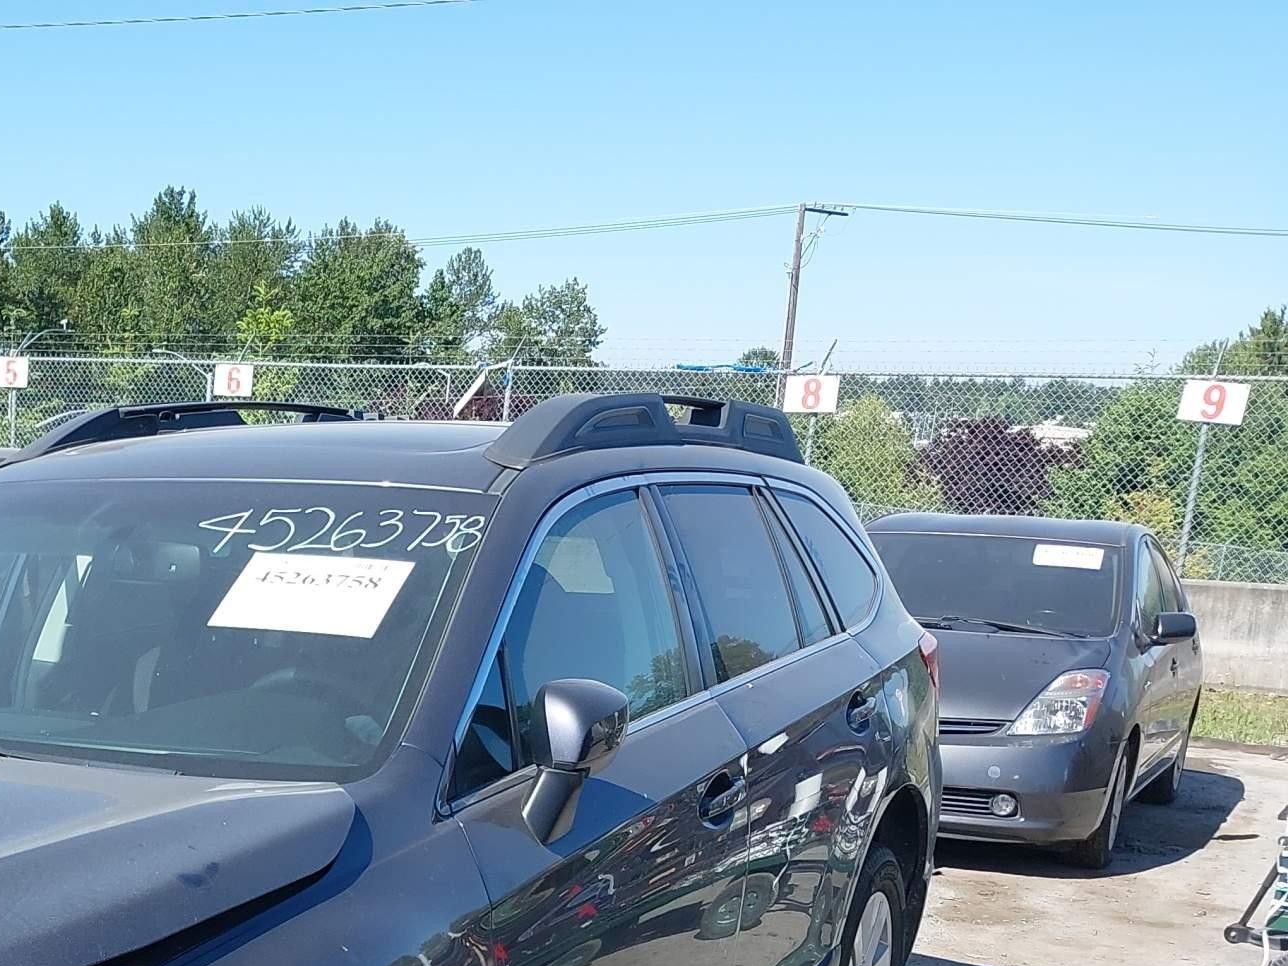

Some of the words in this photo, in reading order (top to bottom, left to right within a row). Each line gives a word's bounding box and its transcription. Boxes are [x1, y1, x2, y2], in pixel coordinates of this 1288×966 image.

[5, 360, 17, 385] 5
[227, 366, 241, 394] 6
[801, 378, 822, 410] 8
[1200, 384, 1227, 420] 9
[197, 506, 486, 553] 45263758
[254, 570, 383, 590] 45263758
